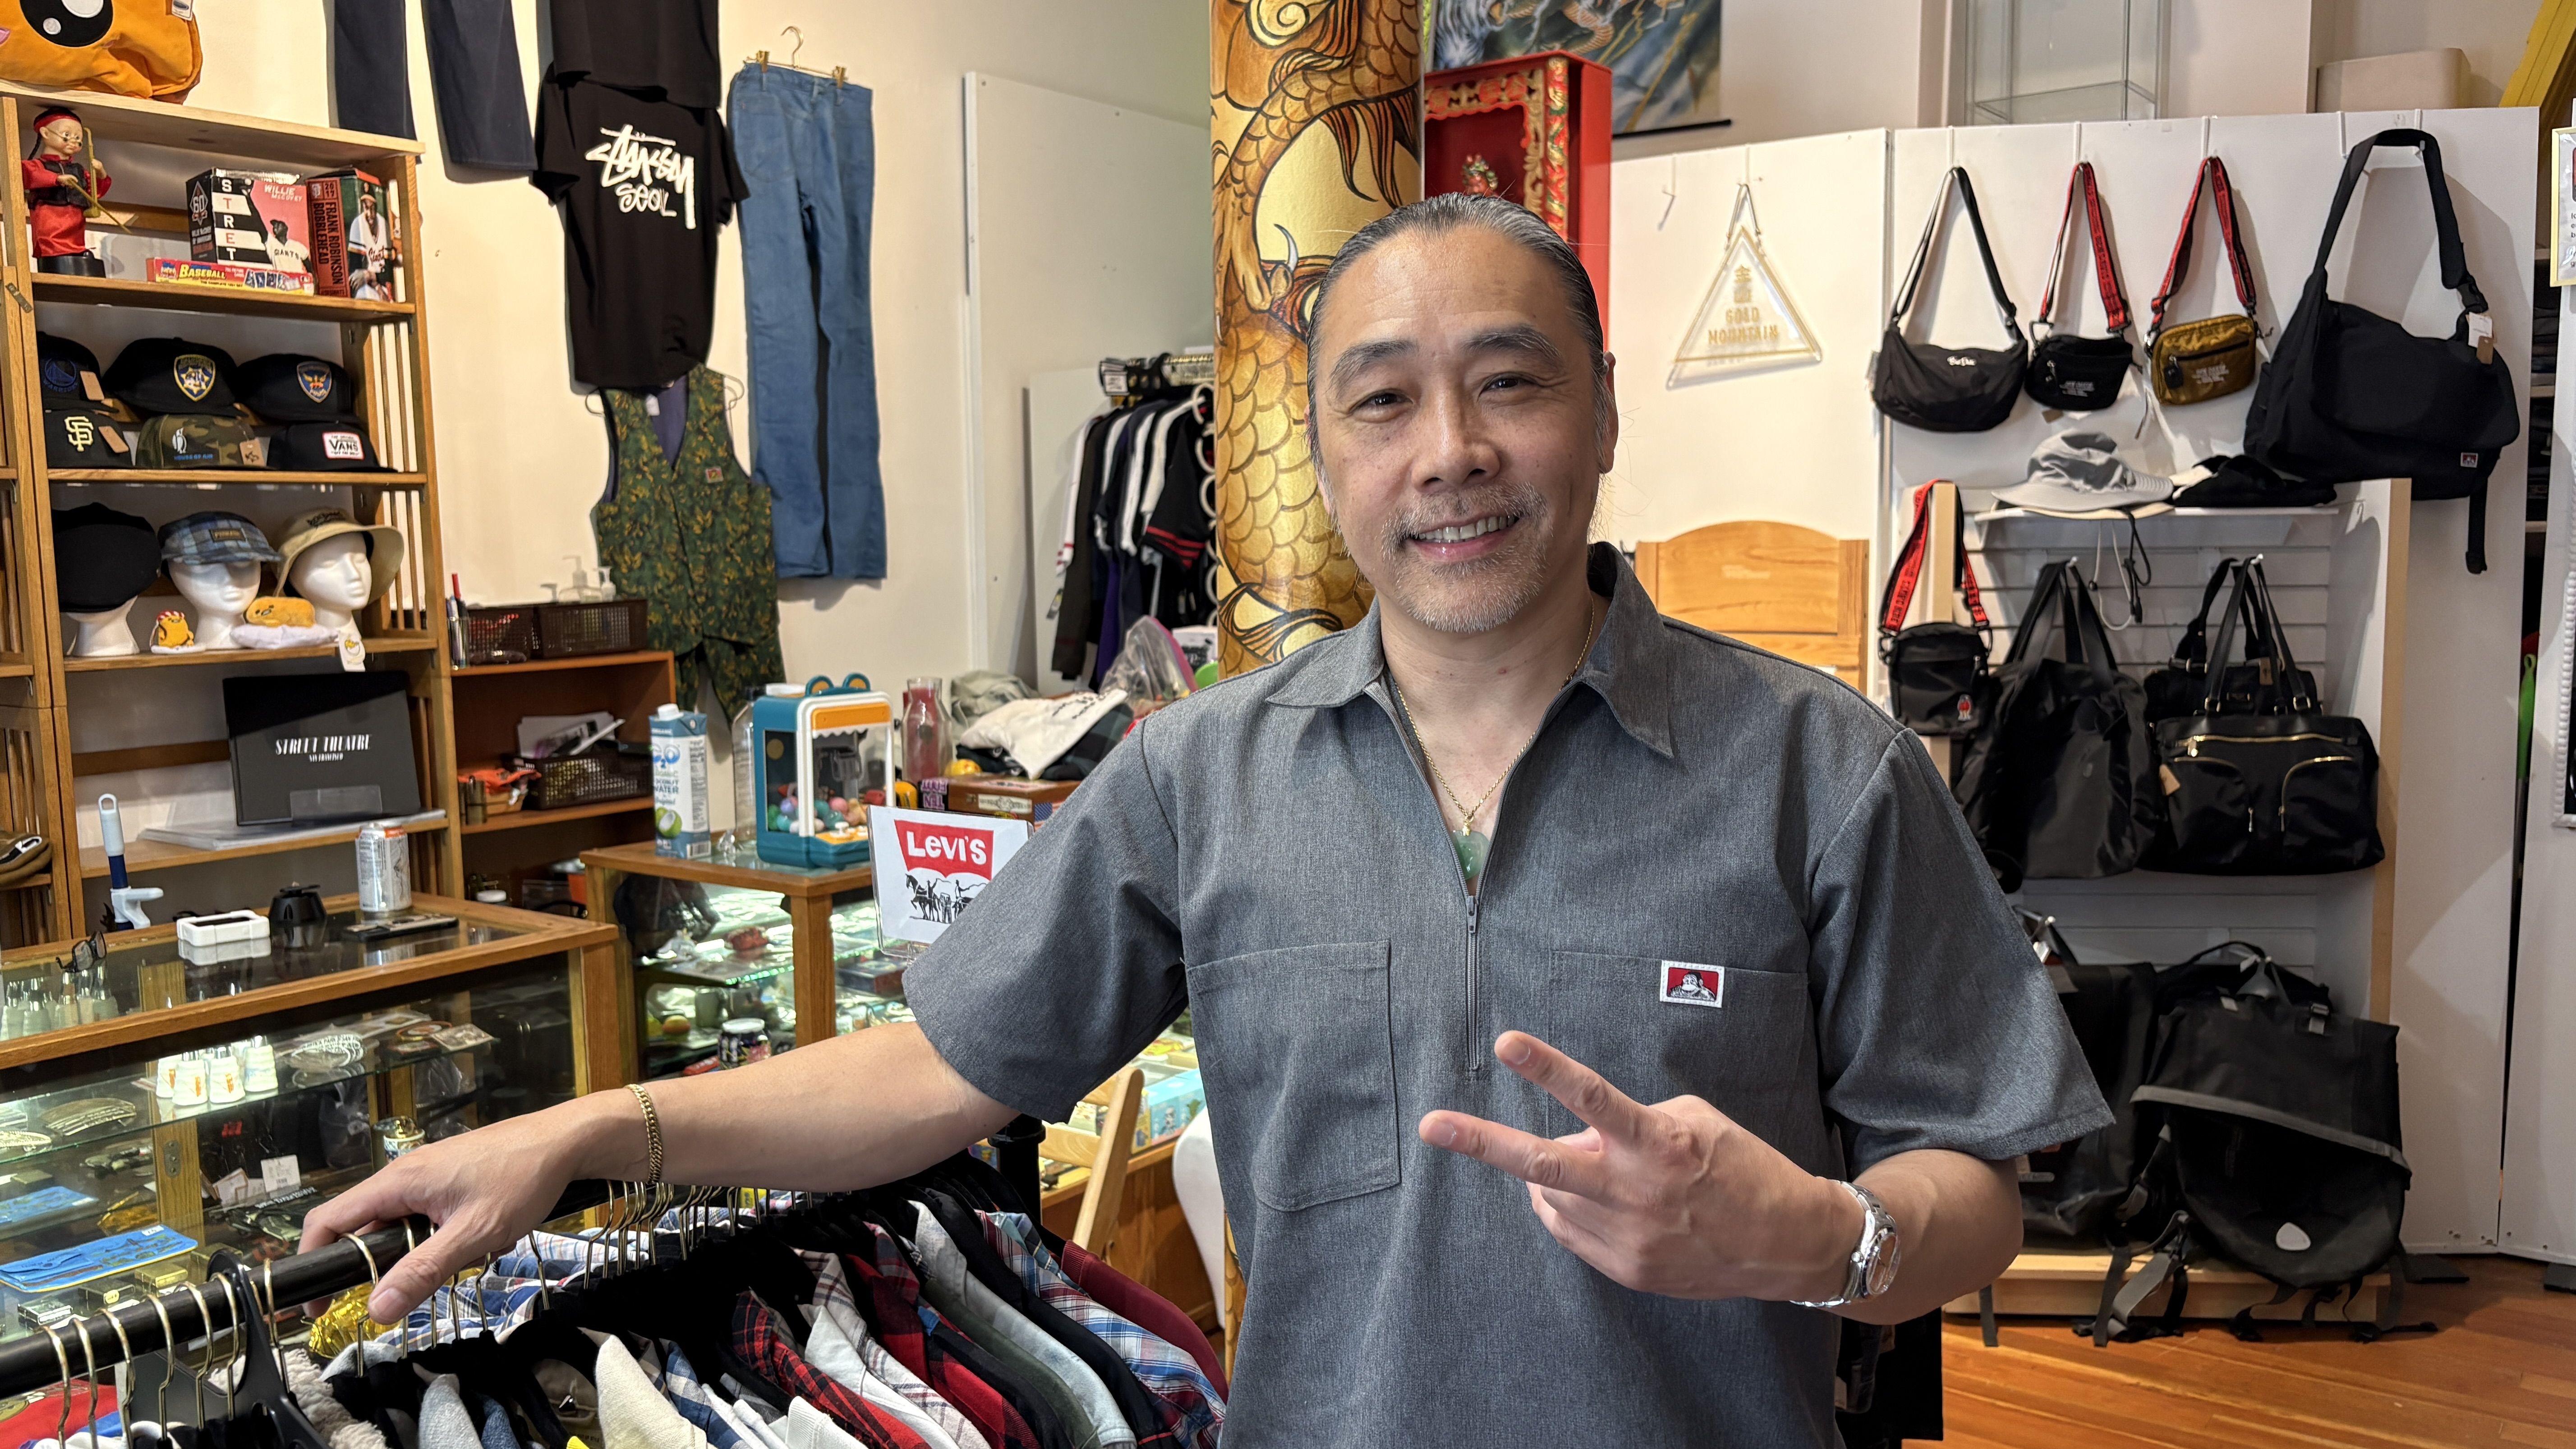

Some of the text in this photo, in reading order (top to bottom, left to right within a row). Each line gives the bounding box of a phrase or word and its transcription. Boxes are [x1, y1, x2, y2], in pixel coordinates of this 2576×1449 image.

[264, 184, 296, 197] WILLIE
[325, 202, 340, 234] FRANK
[313, 202, 329, 264] BOBBLEHEAD
[329, 235, 344, 285] ROBINSON
[179, 264, 226, 279] BASEBALL
[1725, 307, 1760, 323] GOLD
[1708, 324, 1779, 345] MOUNTAIN
[329, 439, 359, 451] VANS
[276, 734, 373, 755] STREET THEATRE
[923, 792, 945, 811] TEN
